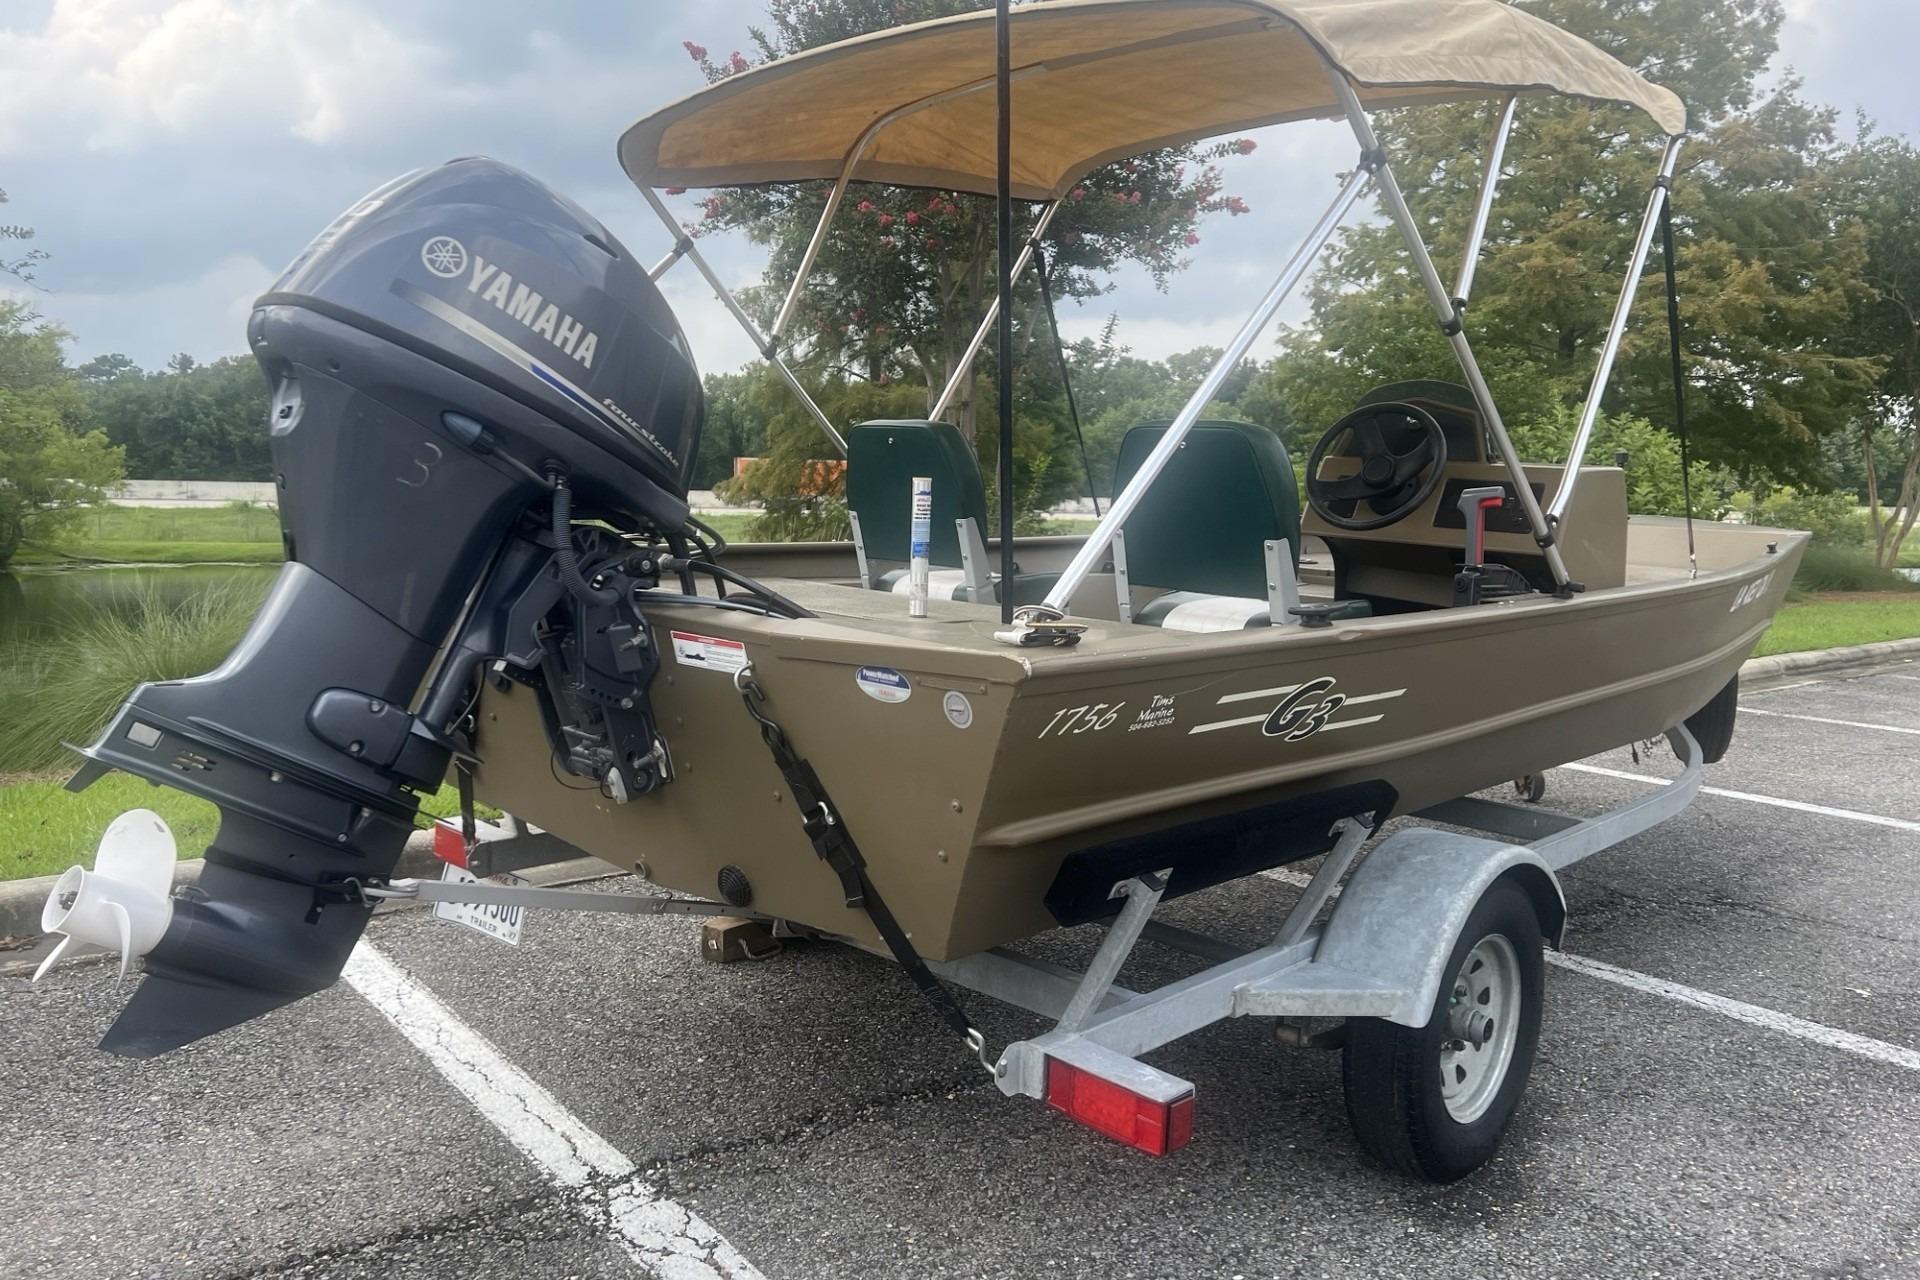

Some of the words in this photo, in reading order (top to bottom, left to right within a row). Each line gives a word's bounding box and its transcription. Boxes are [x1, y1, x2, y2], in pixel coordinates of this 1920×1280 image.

[467, 256, 599, 369] YAMAHA
[1137, 707, 1174, 722] Marine
[1151, 694, 1175, 708] Tims
[1262, 676, 1347, 742] G3
[1038, 701, 1126, 739] 1756
[470, 915, 497, 932] TRAILER
